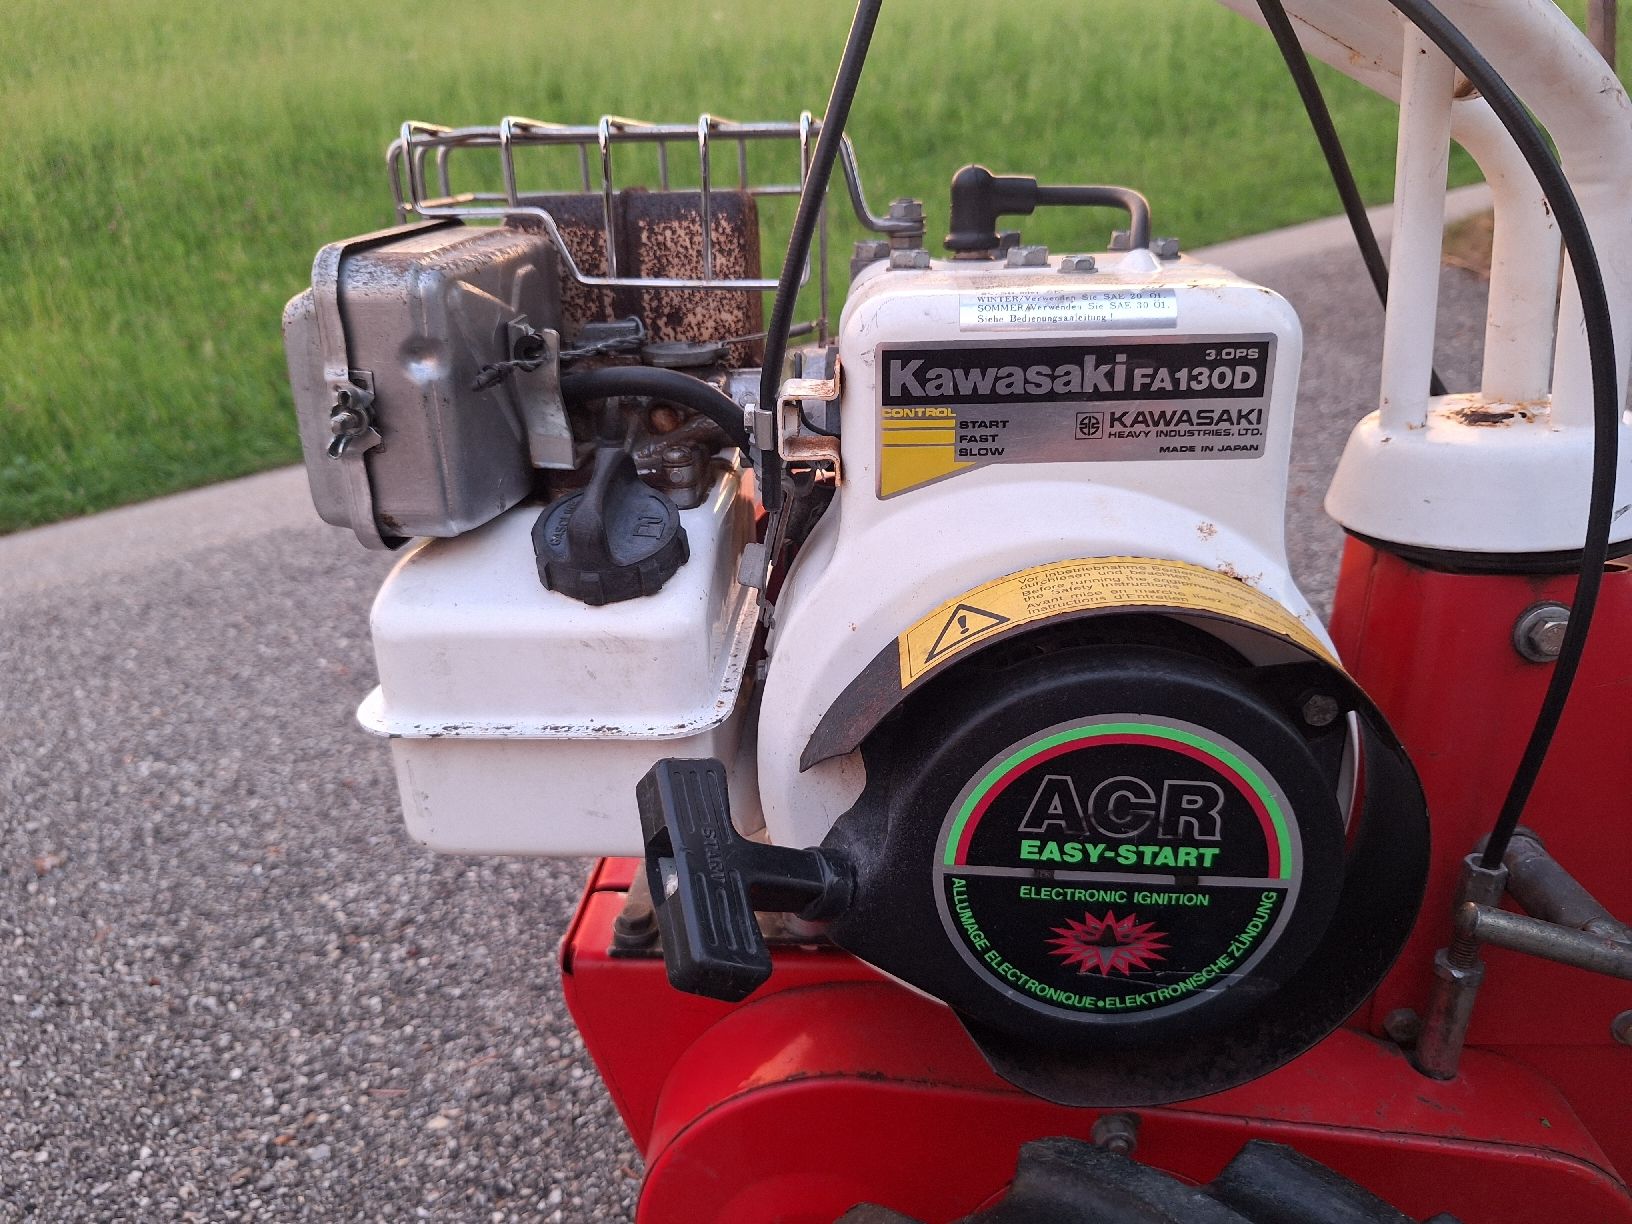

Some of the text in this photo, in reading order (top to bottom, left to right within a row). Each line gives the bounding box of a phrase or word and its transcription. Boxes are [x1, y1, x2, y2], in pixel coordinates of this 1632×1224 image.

[889, 354, 1257, 397] Kawasaki FA130D
[882, 407, 957, 418] CONTROL
[1108, 408, 1263, 429] KAWASAKI
[959, 419, 1010, 430] START
[959, 433, 999, 444] FAST
[1108, 430, 1152, 439] HEAVY
[1237, 428, 1263, 437] LTD.
[958, 447, 1005, 458] SLOW
[1159, 443, 1259, 454] MADE IN JAPAN
[1018, 575, 1039, 584] Vor
[1018, 774, 1225, 842] ACR
[1020, 840, 1221, 869] EASY-START
[1020, 885, 1210, 907] ELECTRONIC IGNITION
[951, 877, 991, 952] ALLUMAGE
[1228, 890, 1278, 958] ZÜNDUNG
